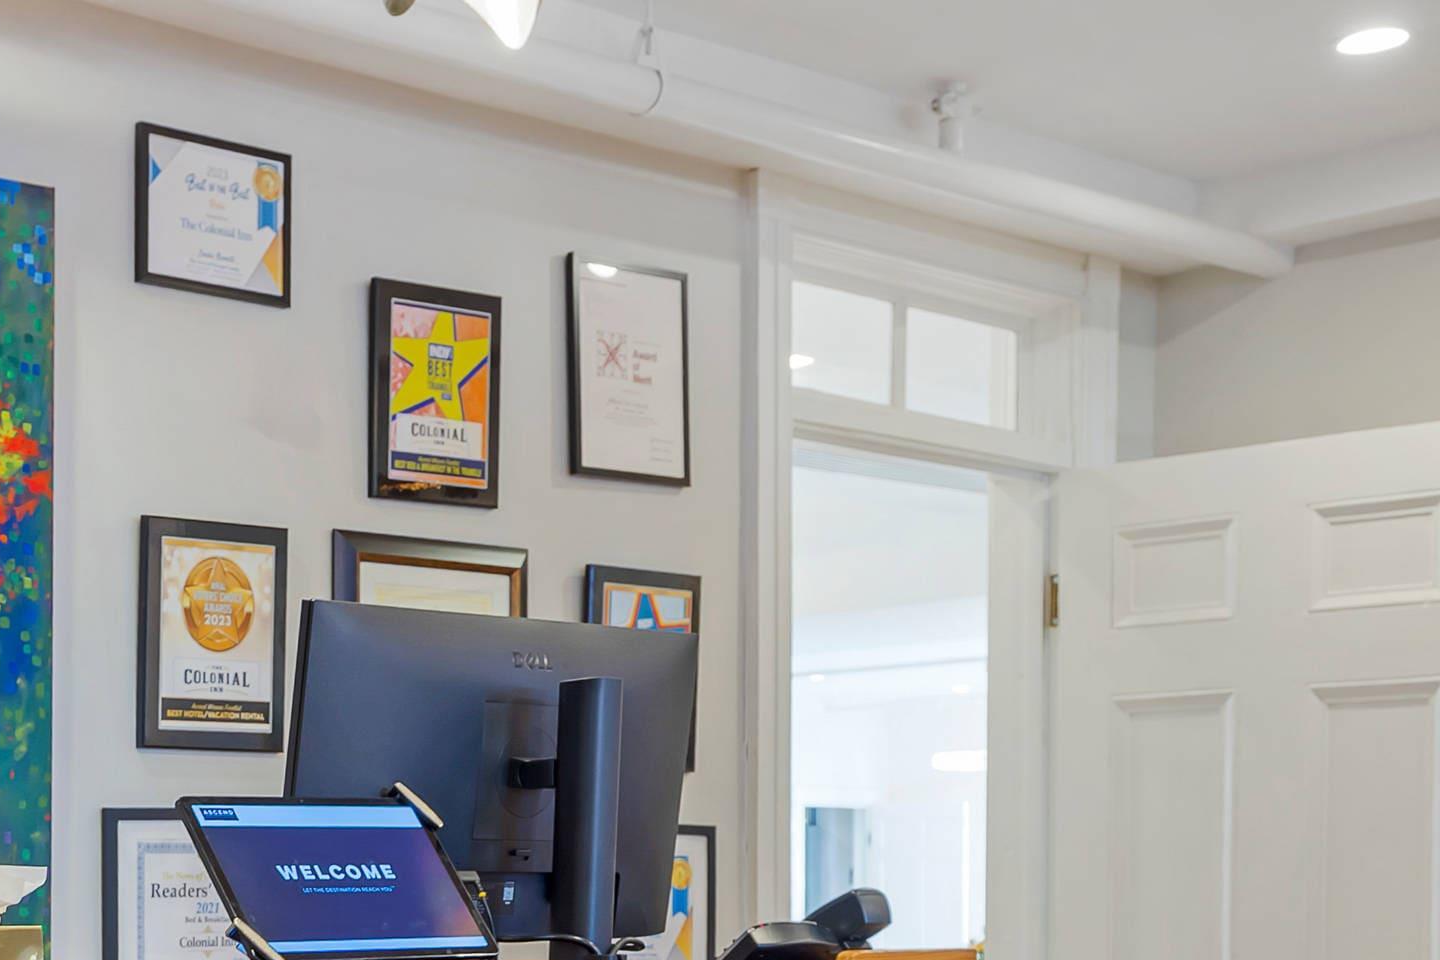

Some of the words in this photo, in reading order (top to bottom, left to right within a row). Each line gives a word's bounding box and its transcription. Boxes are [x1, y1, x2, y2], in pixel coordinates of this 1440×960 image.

[180, 216, 197, 230] The
[198, 222, 236, 239] Colonial
[237, 227, 253, 241] Inn
[428, 360, 452, 377] BEST
[411, 422, 467, 443] COLONIAL
[204, 614, 232, 626] 2023
[184, 668, 250, 688] COLONIAL
[275, 864, 397, 880] WELCOME
[151, 883, 212, 898] Readers'
[196, 902, 219, 914] 2021
[179, 936, 219, 948] Colonial
